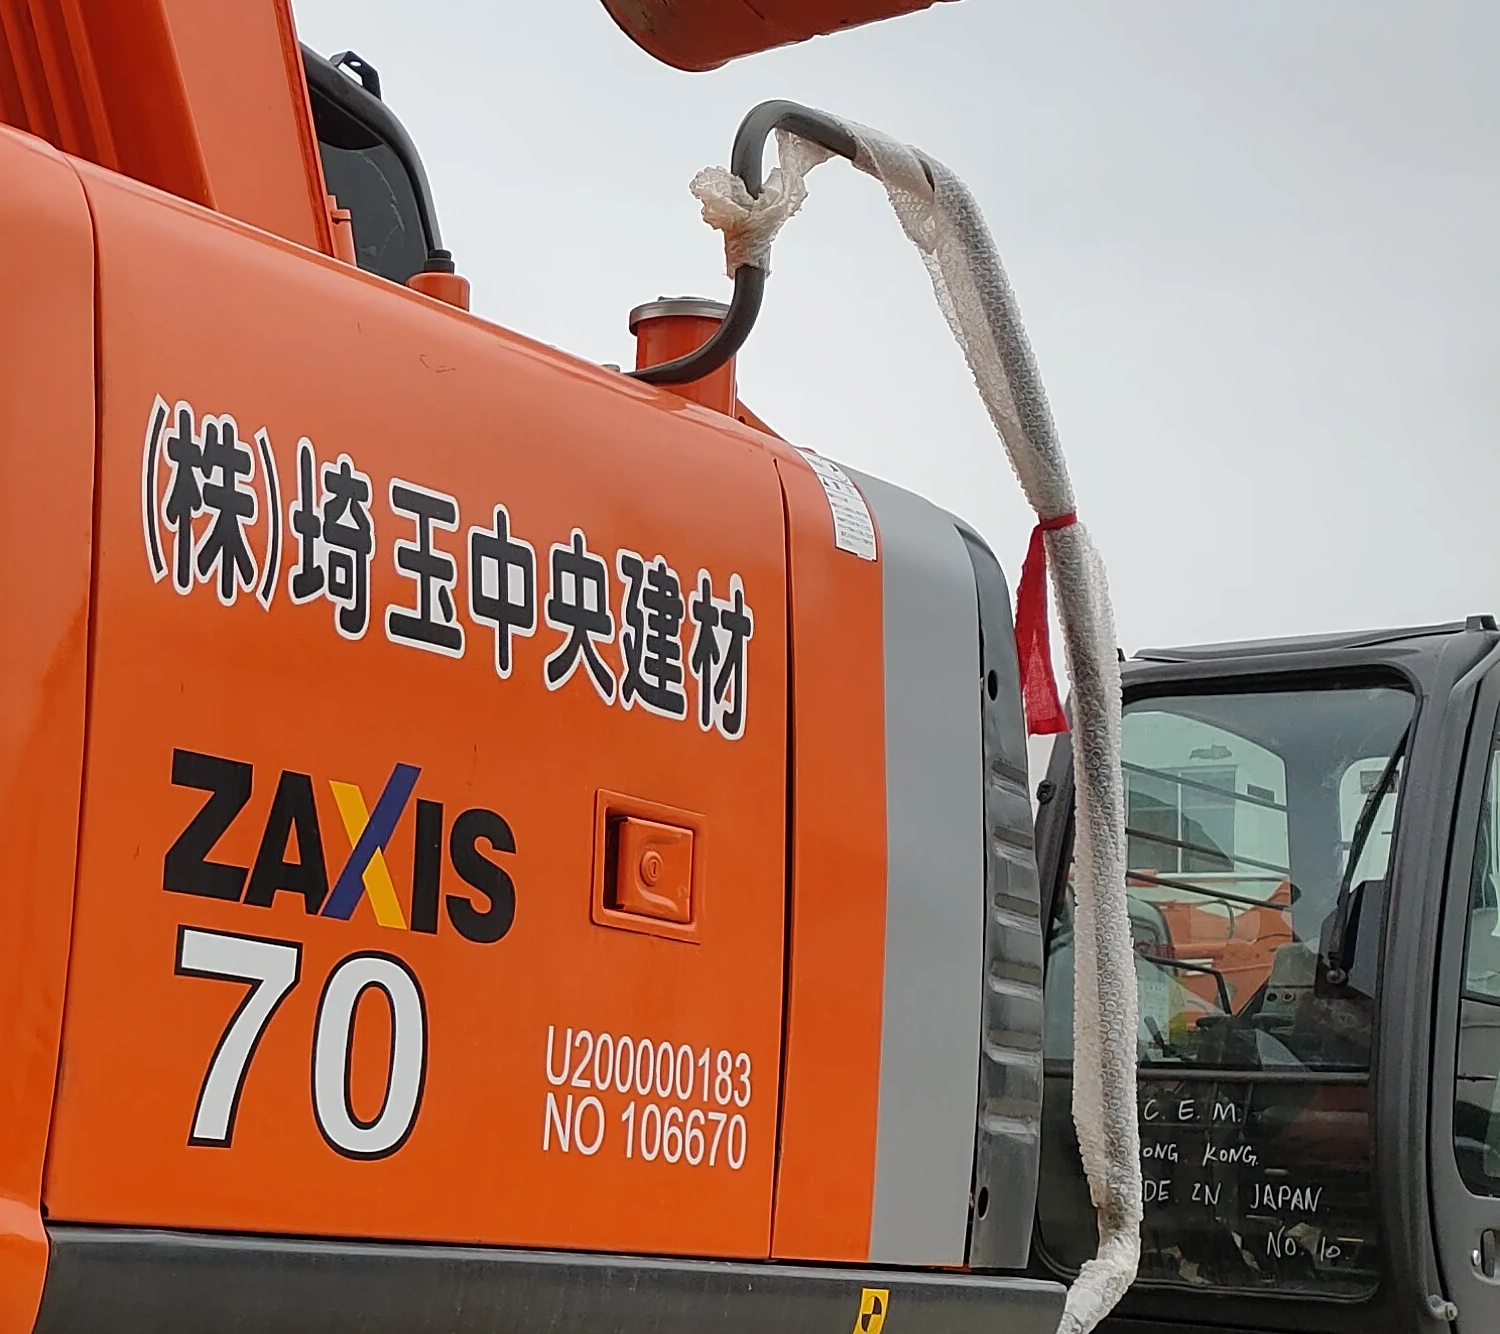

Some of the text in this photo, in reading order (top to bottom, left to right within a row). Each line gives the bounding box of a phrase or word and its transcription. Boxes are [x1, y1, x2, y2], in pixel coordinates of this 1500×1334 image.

[142, 393, 754, 740] (株)埼玉中央建材
[162, 747, 517, 944] ZAXIS
[174, 924, 428, 1161] 70
[543, 1092, 748, 1170] NO 106670
[546, 1025, 752, 1108] U200000183
